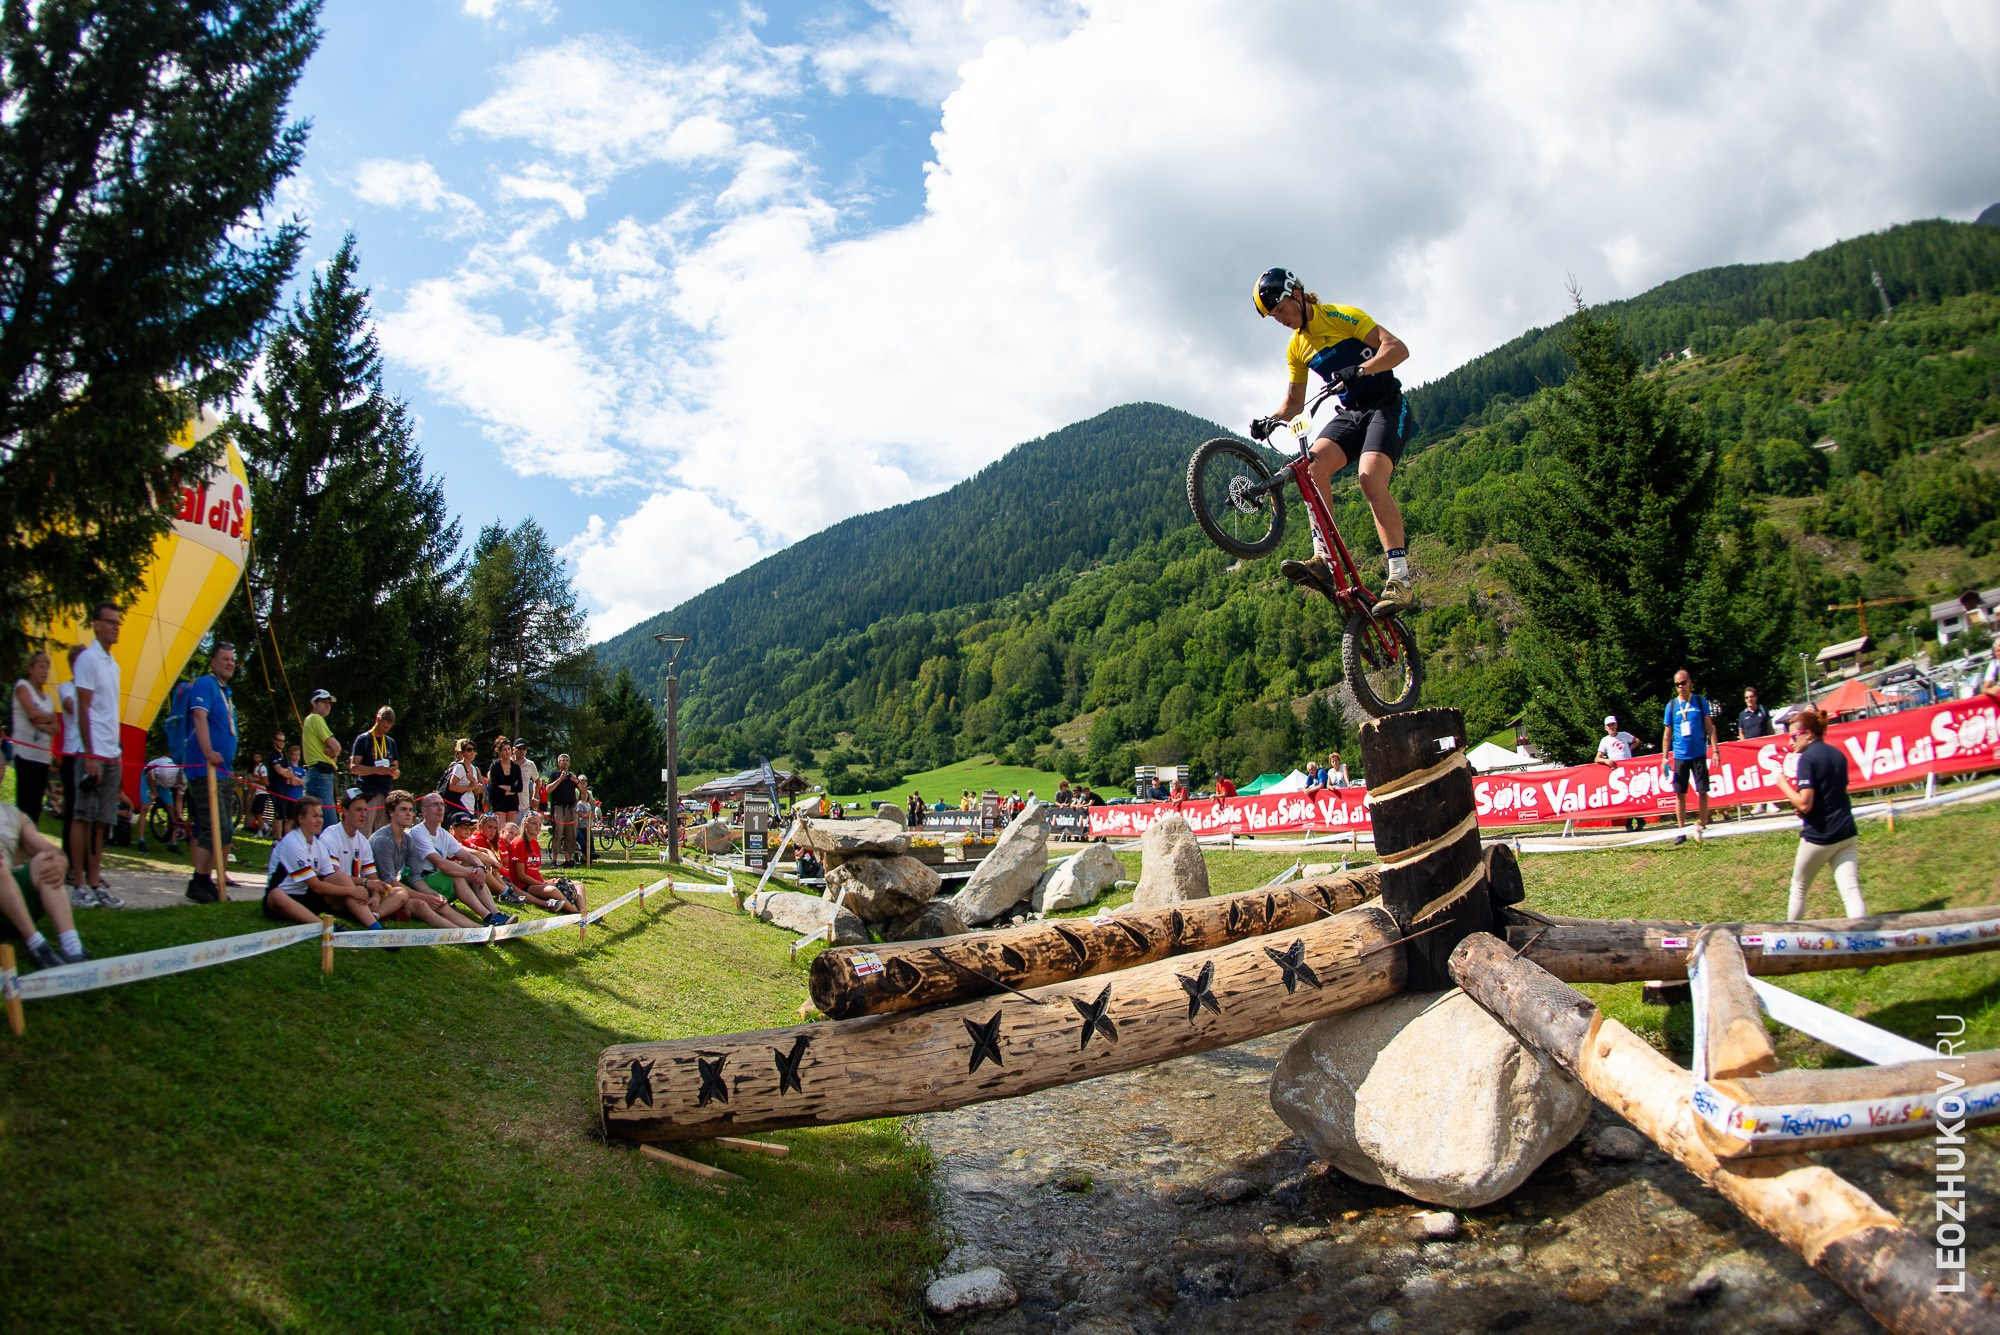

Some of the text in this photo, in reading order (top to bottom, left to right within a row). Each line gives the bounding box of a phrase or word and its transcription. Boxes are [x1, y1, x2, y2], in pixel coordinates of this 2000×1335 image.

[208, 499, 230, 533] di
[1844, 707, 2000, 781] Val di Sol
[1474, 766, 1674, 817] Sole Val di Sole
[1736, 765, 1761, 791] di
[752, 815, 759, 830] 1
[986, 806, 993, 816] 2
[1089, 812, 1104, 833] Val
[1131, 811, 1148, 833] Val
[1182, 808, 1202, 831] Val
[1203, 814, 1212, 829] di
[1211, 803, 1242, 827] Sole
[1244, 802, 1267, 831] Val
[1267, 810, 1279, 826] di
[1277, 798, 1316, 825] Sole
[1318, 797, 1349, 828] Val
[1350, 805, 1364, 823] di
[1796, 936, 1811, 950] Val
[1845, 935, 1886, 952] TRENTINO
[1735, 1109, 1769, 1133] Sole
[1780, 1112, 1852, 1137] TRENTINO
[1867, 1105, 1889, 1128] Val
[1901, 1103, 1934, 1123] Sole
